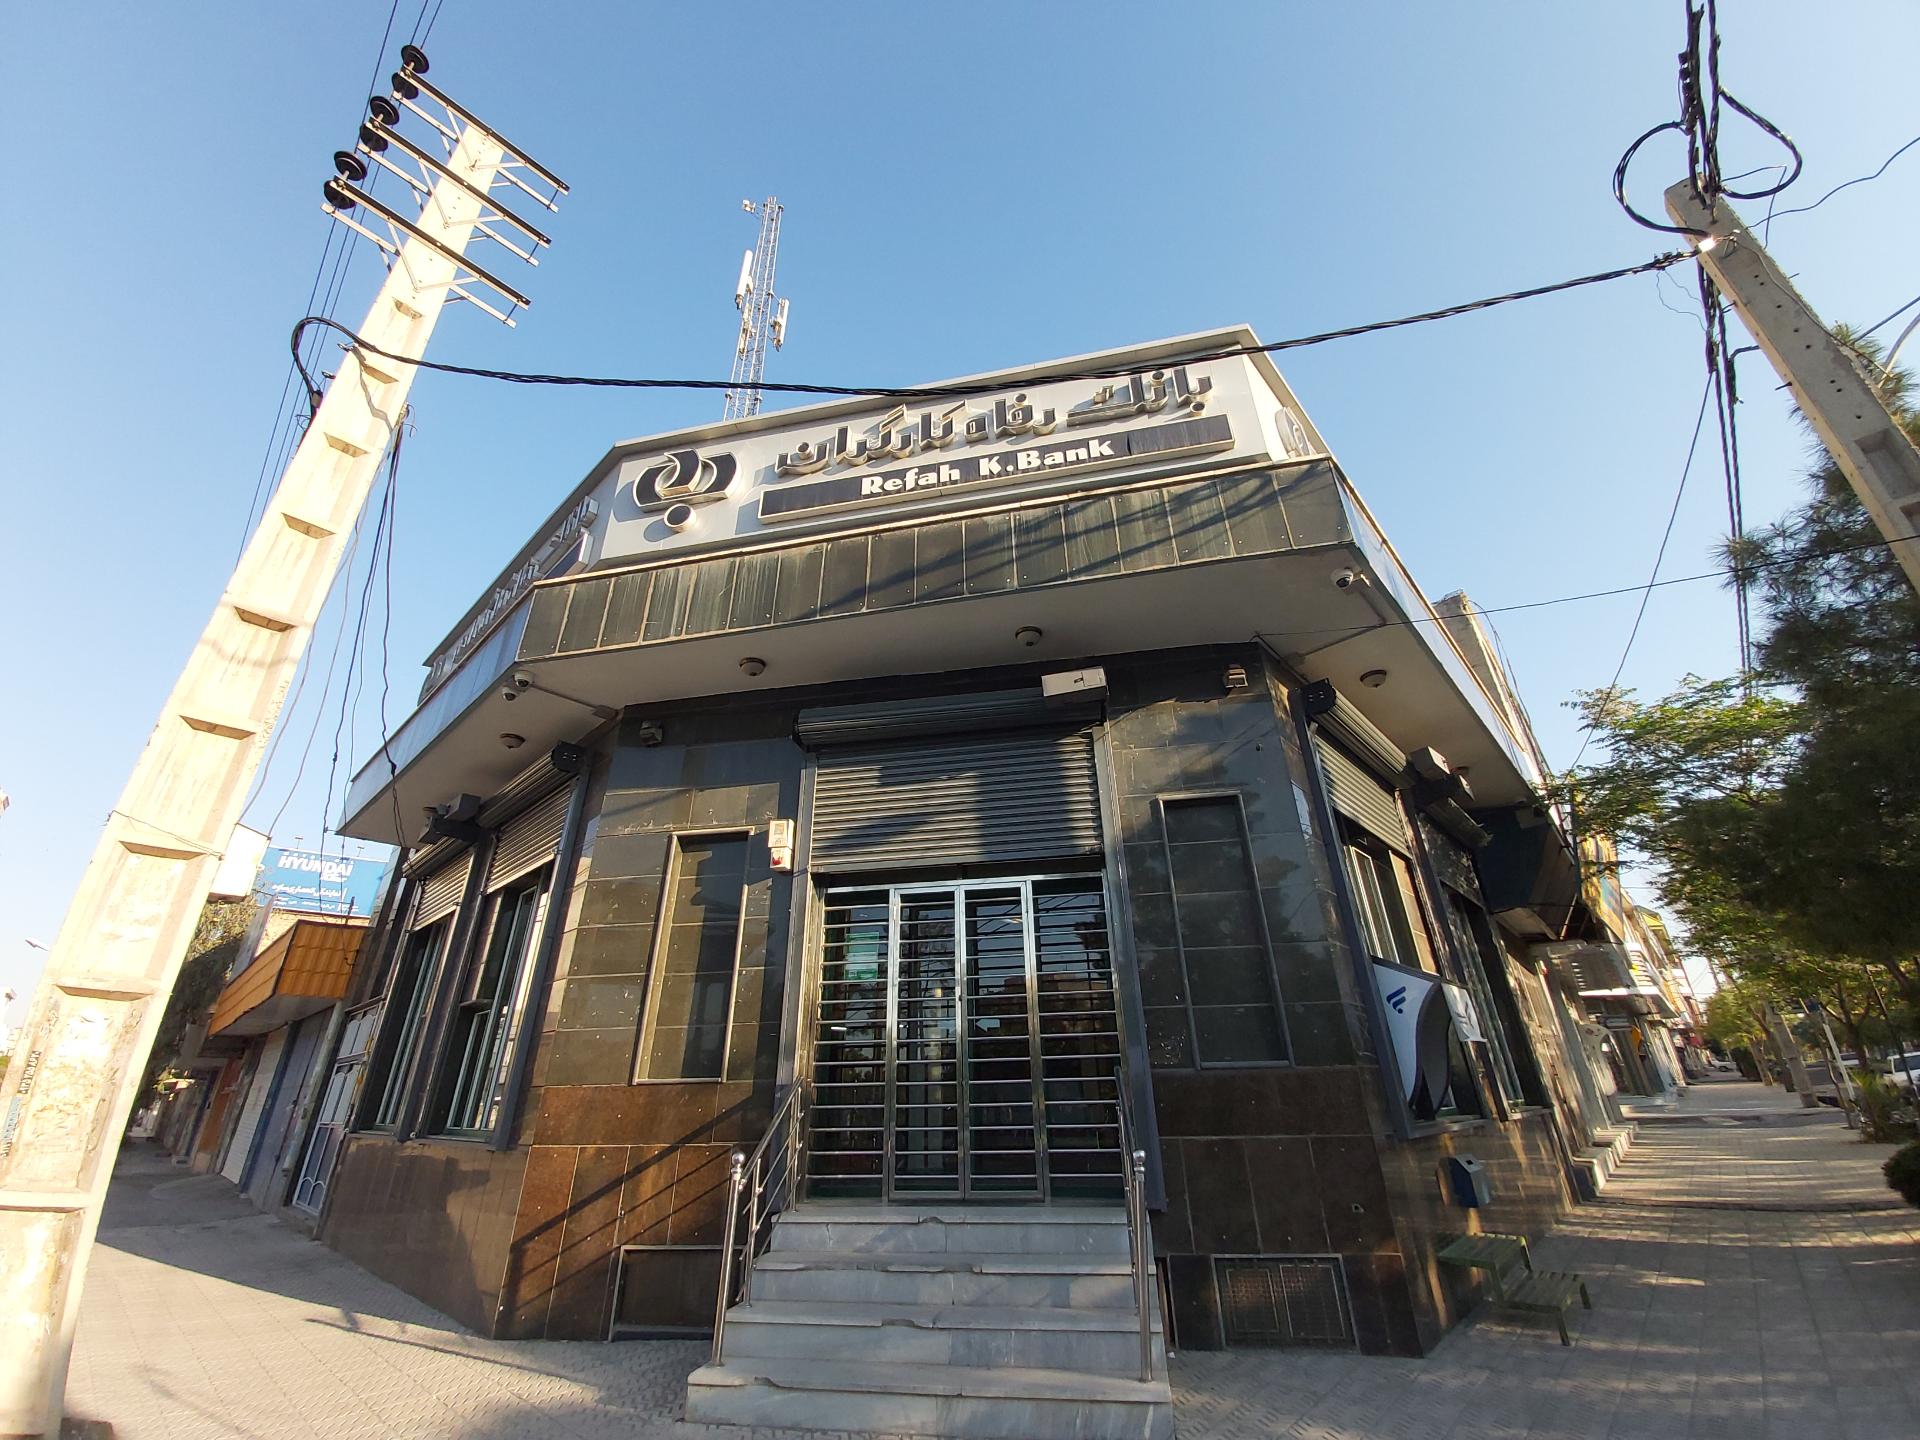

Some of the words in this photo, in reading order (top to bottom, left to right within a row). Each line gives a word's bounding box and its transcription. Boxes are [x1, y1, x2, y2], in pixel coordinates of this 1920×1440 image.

[964, 393, 1056, 443] رفاه
[1066, 366, 1214, 427] بانک
[774, 401, 968, 475] کارگران
[861, 464, 961, 495] Refah
[978, 439, 1115, 477] K.Bank
[278, 855, 354, 876] HYUNDAI
